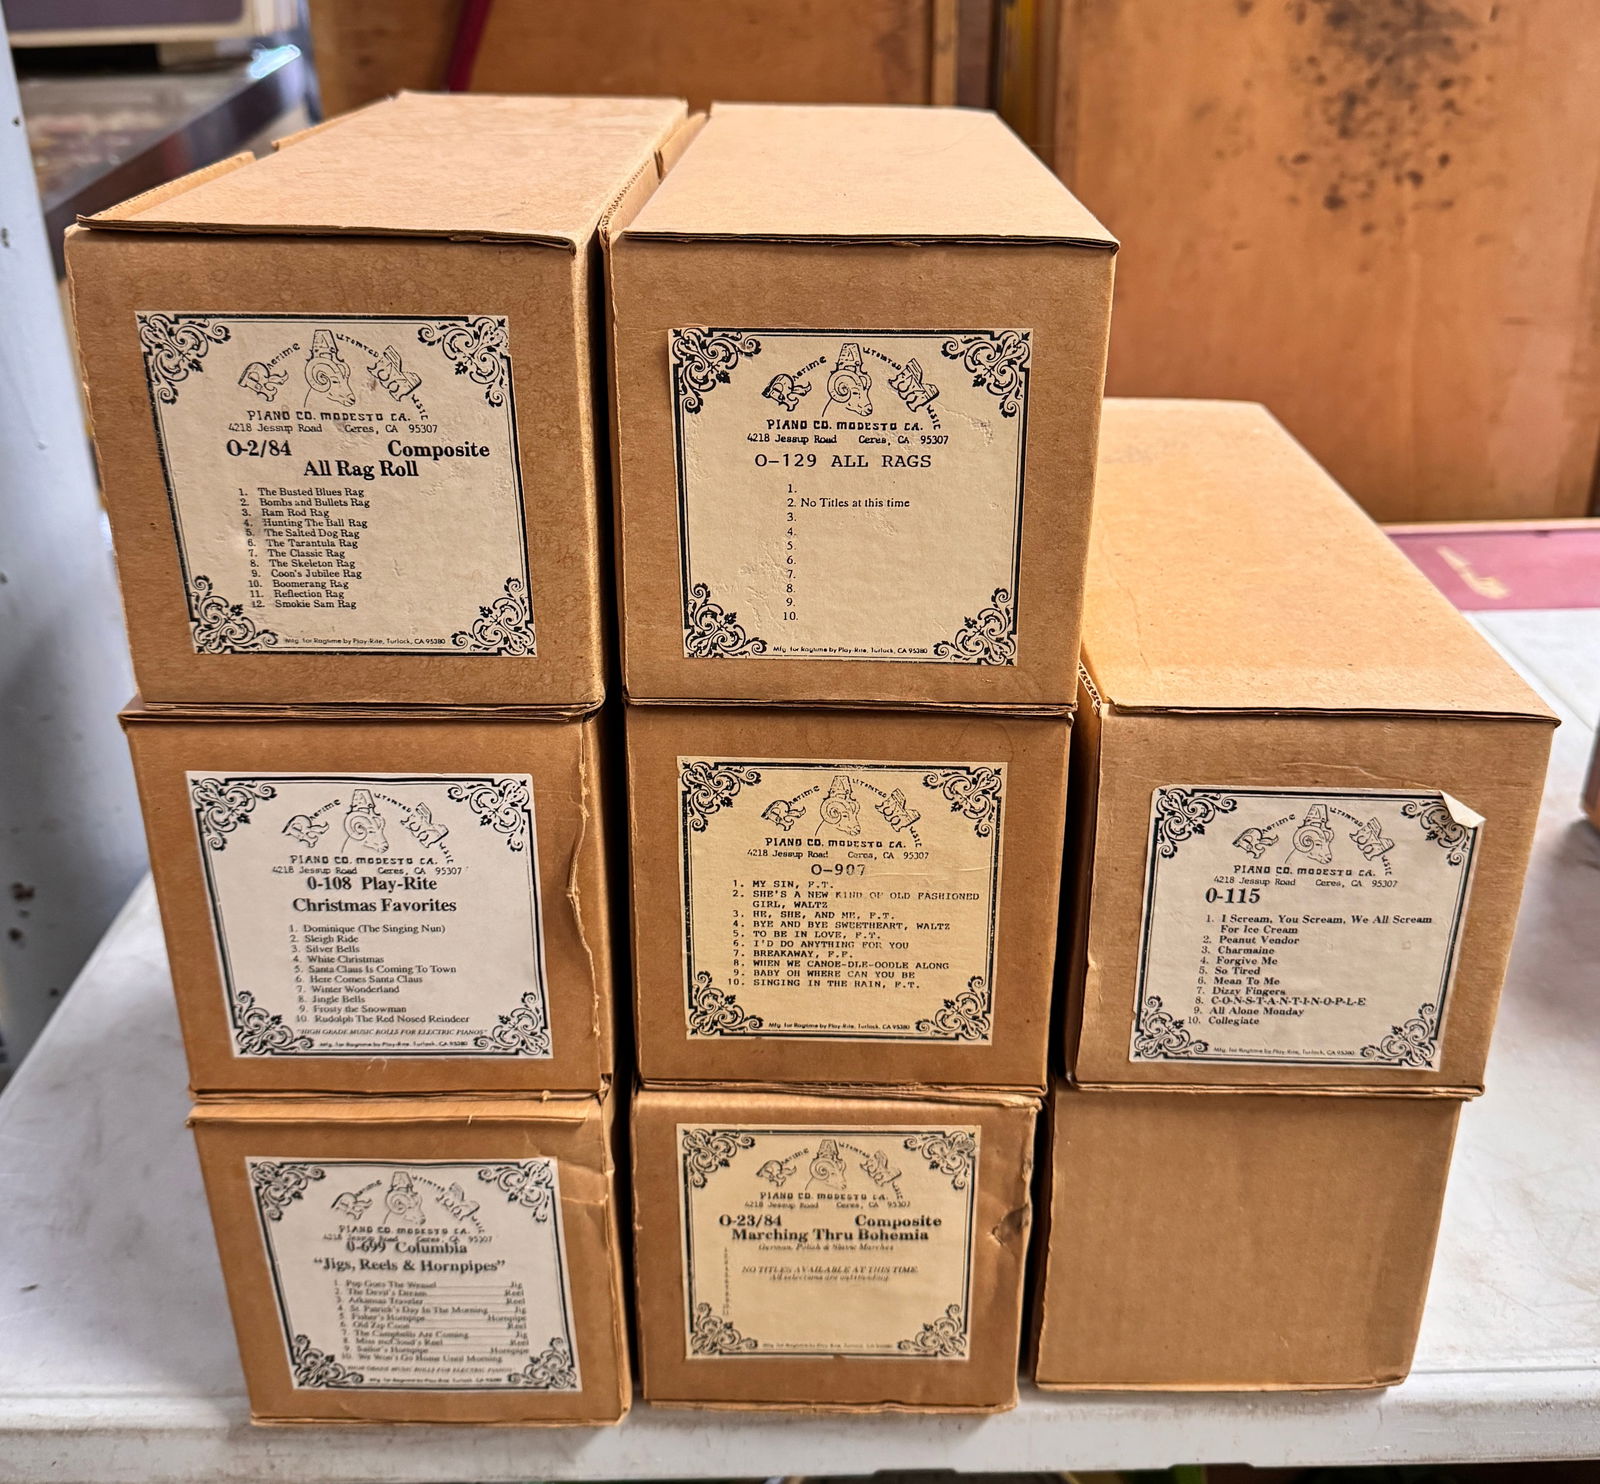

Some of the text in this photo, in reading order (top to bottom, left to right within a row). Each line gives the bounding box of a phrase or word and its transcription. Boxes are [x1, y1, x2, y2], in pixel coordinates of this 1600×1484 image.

[228, 422, 438, 434] 4218 Jessup Road Ceres, CA 95307
[747, 433, 770, 442] 4218
[774, 434, 810, 446] Jessup
[897, 435, 910, 444] CA
[920, 435, 949, 445] 95307
[387, 439, 490, 460] Composite
[831, 454, 869, 468] ALL
[881, 454, 931, 468] RAGS
[303, 460, 420, 480] All Rag Roll
[238, 487, 365, 500] 1. The Busted Blues Rag
[788, 484, 797, 494] 1.
[239, 498, 370, 509] 2. Bombs and Bullets Rag
[787, 498, 910, 508] 2. No Titles at this time
[241, 508, 330, 518] 3. Ram Rod Rag
[787, 512, 796, 522] 3.
[263, 518, 303, 530] Hunting
[304, 518, 324, 527] The
[325, 518, 345, 527] Ball
[348, 518, 368, 530] Rag
[787, 527, 797, 536] 4.
[787, 540, 796, 550] 5.
[248, 548, 346, 560] 7. The Classic Rag
[786, 554, 796, 565] 6.
[786, 568, 796, 579] 7.
[248, 578, 349, 590] 10. Boomerang Rag
[786, 583, 796, 593] 8.
[786, 597, 796, 607] 9.
[783, 611, 798, 621] 10.
[361, 876, 437, 894] Play-Rite
[733, 880, 744, 888] 1.
[752, 880, 766, 888] MY
[773, 880, 799, 889] SIN,
[292, 898, 457, 912] Christmas Favorites
[752, 900, 828, 909] GIRL, WALTZ
[1206, 914, 1432, 924] 1. I Scream, You Scream, We All Scream
[303, 924, 355, 934] Dominique
[358, 924, 381, 934] (The
[382, 924, 419, 934] Singing
[421, 924, 445, 933] Nun)
[733, 920, 745, 929] 4.
[752, 920, 775, 929] BYE
[780, 920, 801, 928] AND
[808, 920, 828, 928] BYE
[916, 922, 950, 930] WALTZ
[1220, 924, 1298, 934] For Ice Cream
[1203, 935, 1300, 945] 2. Peanut Vendor
[291, 944, 360, 953] 3. Silver Bells
[292, 954, 384, 964] 4. White Christmas
[1200, 956, 1278, 966] 4. Forgive Me
[294, 965, 456, 974] 5. Santa Claus Is Coming To Town
[728, 978, 745, 986] 10.
[753, 978, 800, 987] SINGING
[296, 984, 400, 994] 7. Winter Wonderland
[854, 1214, 942, 1230] Composite
[732, 1228, 929, 1244] Marching Thru Bohemia
[394, 1242, 468, 1254] Columbia
[359, 1258, 398, 1271] Reels
[402, 1260, 416, 1272] &
